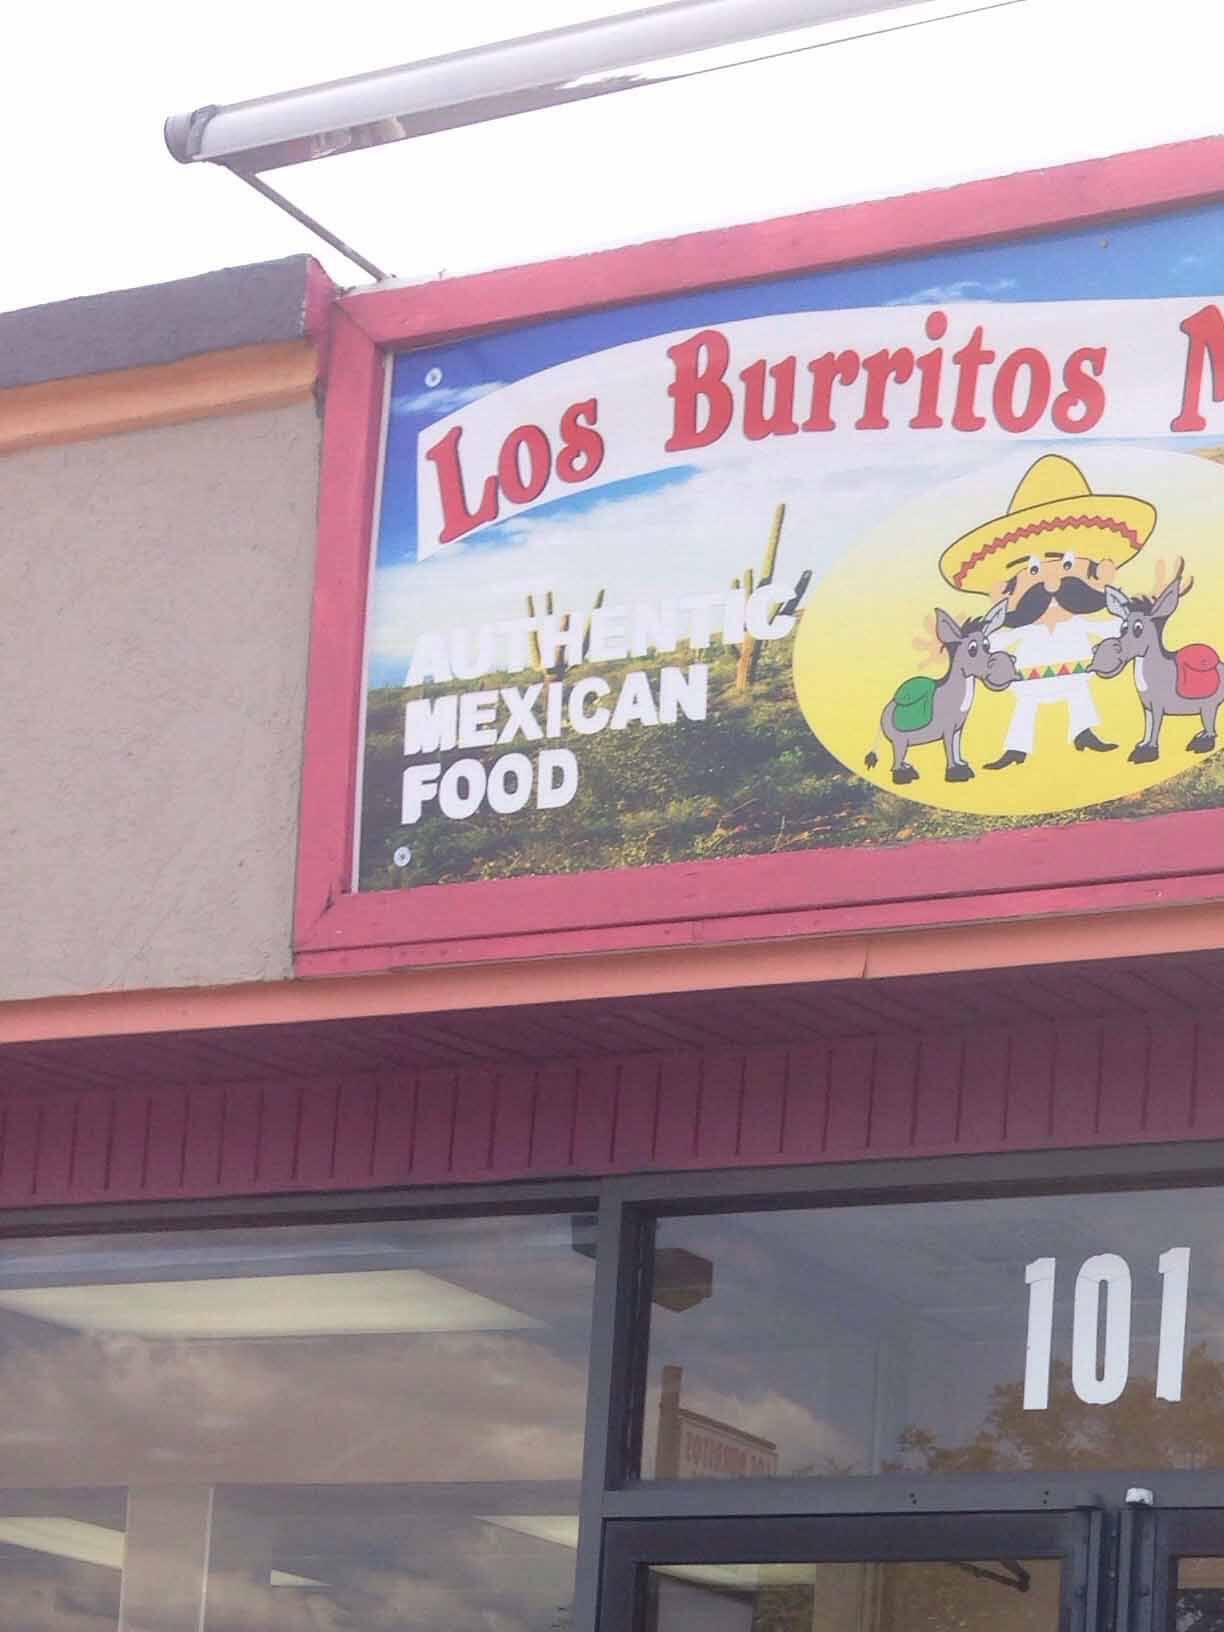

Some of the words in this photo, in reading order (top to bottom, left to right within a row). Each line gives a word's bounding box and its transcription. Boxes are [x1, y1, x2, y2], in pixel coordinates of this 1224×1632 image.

[425, 396, 604, 545] Los
[664, 311, 1107, 454] Burritos
[404, 581, 801, 688] AUTHENTIC
[403, 663, 708, 756] MEXICAN
[401, 749, 579, 824] FOOD
